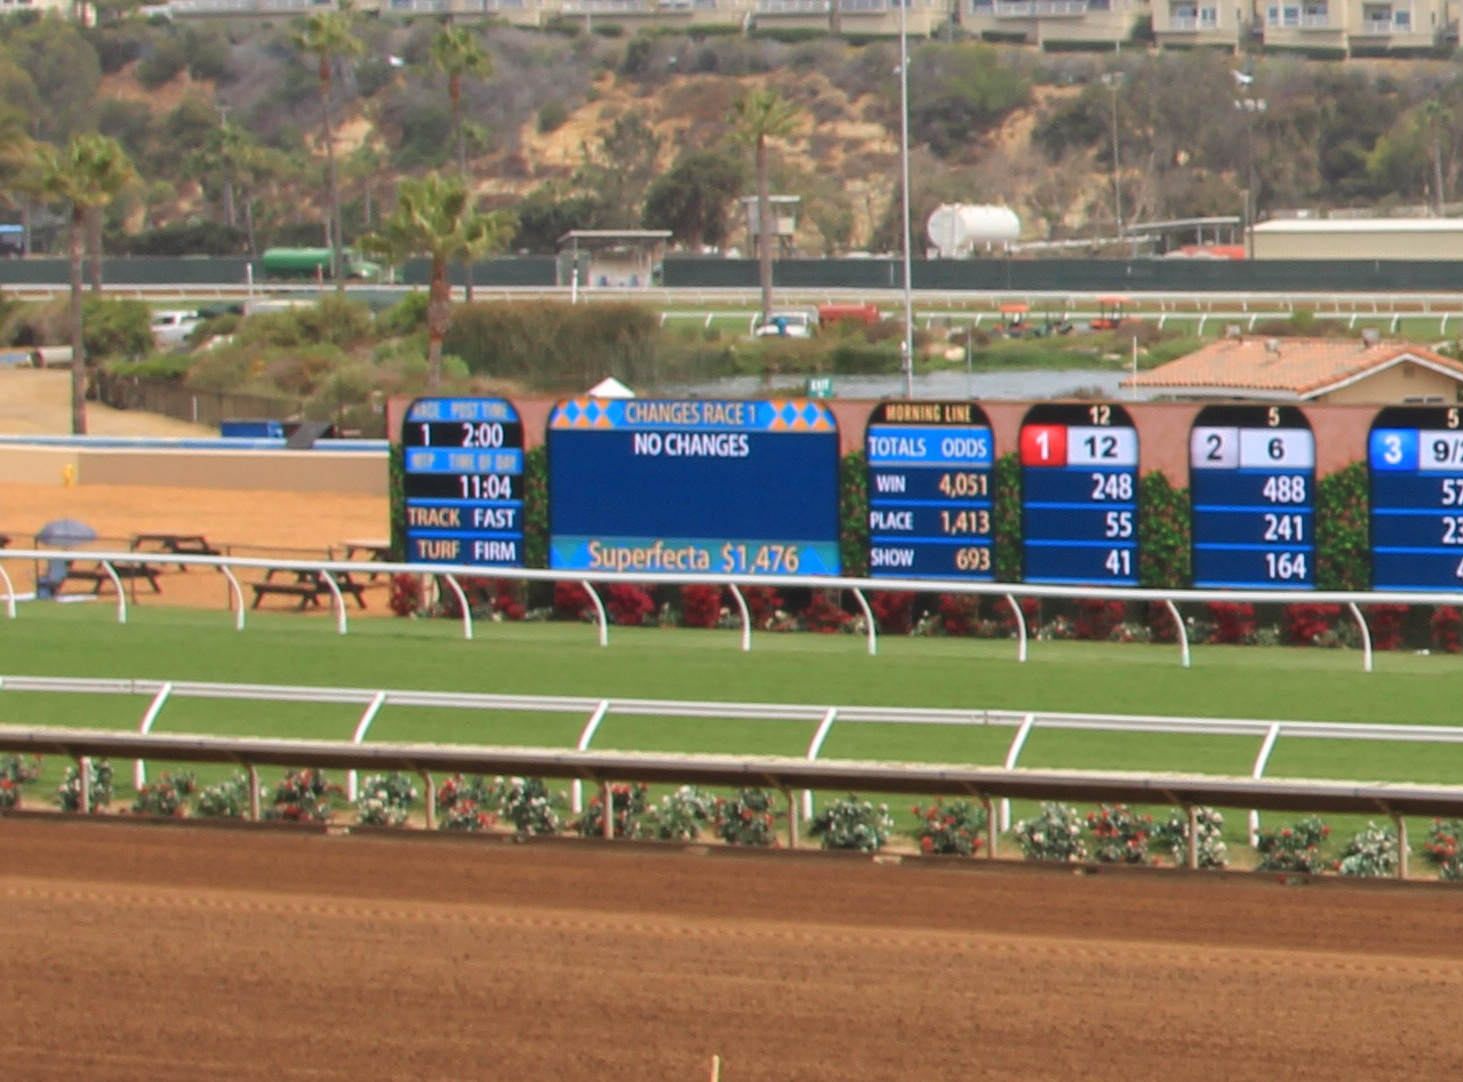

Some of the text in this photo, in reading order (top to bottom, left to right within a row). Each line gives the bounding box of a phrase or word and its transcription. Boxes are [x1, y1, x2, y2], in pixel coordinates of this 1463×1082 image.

[625, 402, 756, 424] CHANGES RACE 1
[885, 403, 971, 422] MORNING LINE
[1089, 405, 1110, 424] 12
[1268, 407, 1280, 427] 5
[1447, 409, 1459, 429] 5
[422, 422, 504, 448] 1 2:00
[634, 433, 750, 457] NO CHANGES
[868, 436, 988, 457] TOTALS ODDS
[1036, 433, 1119, 461] 1 12
[1206, 434, 1286, 460] 2 6
[1384, 436, 1402, 461] 3
[460, 474, 512, 499] 11:04
[876, 473, 989, 497] WIN 4,051
[1091, 473, 1133, 500] 248
[1263, 475, 1306, 503] 488
[408, 507, 514, 528] TRACK FAST
[870, 511, 991, 536] PLACE 1,413
[1105, 513, 1132, 538] 55
[1264, 514, 1304, 541] 241
[417, 539, 516, 561] TURF FIRM
[588, 541, 799, 573] Superfecta $1,476
[870, 548, 991, 571] SHOW 693
[1105, 549, 1131, 575] 41
[1266, 551, 1307, 579] 164
